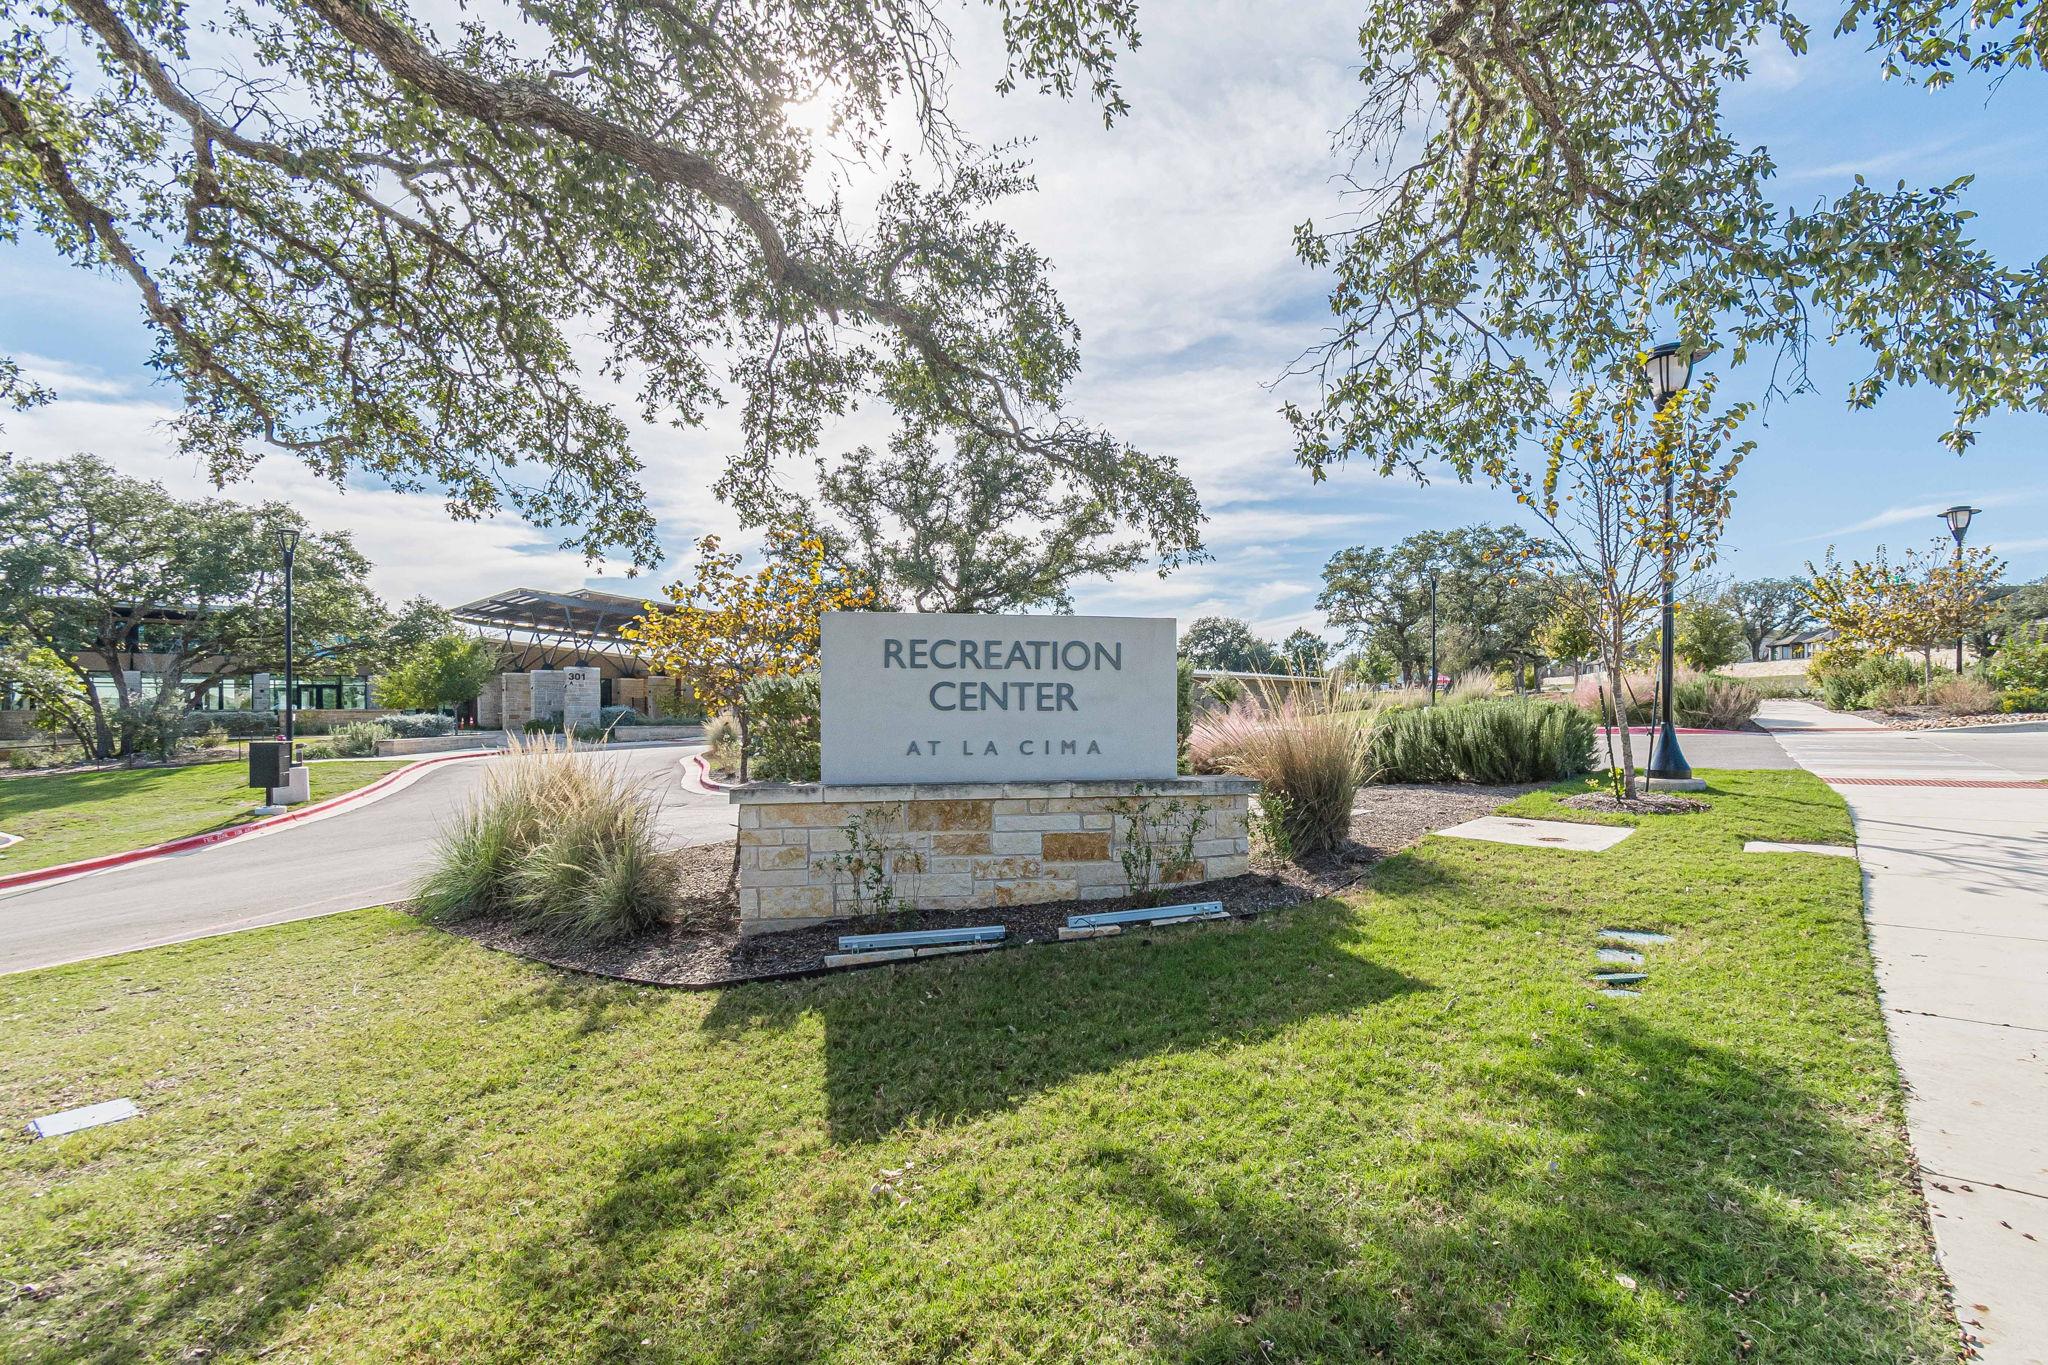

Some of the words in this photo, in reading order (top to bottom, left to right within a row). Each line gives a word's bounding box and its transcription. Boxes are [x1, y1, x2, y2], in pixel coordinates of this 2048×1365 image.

[884, 638, 1122, 670] RECREATION
[568, 672, 586, 680] 301
[929, 681, 1079, 712] CENTER
[905, 740, 942, 756] AT
[962, 740, 999, 756] LA
[1019, 740, 1102, 756] CIMA
